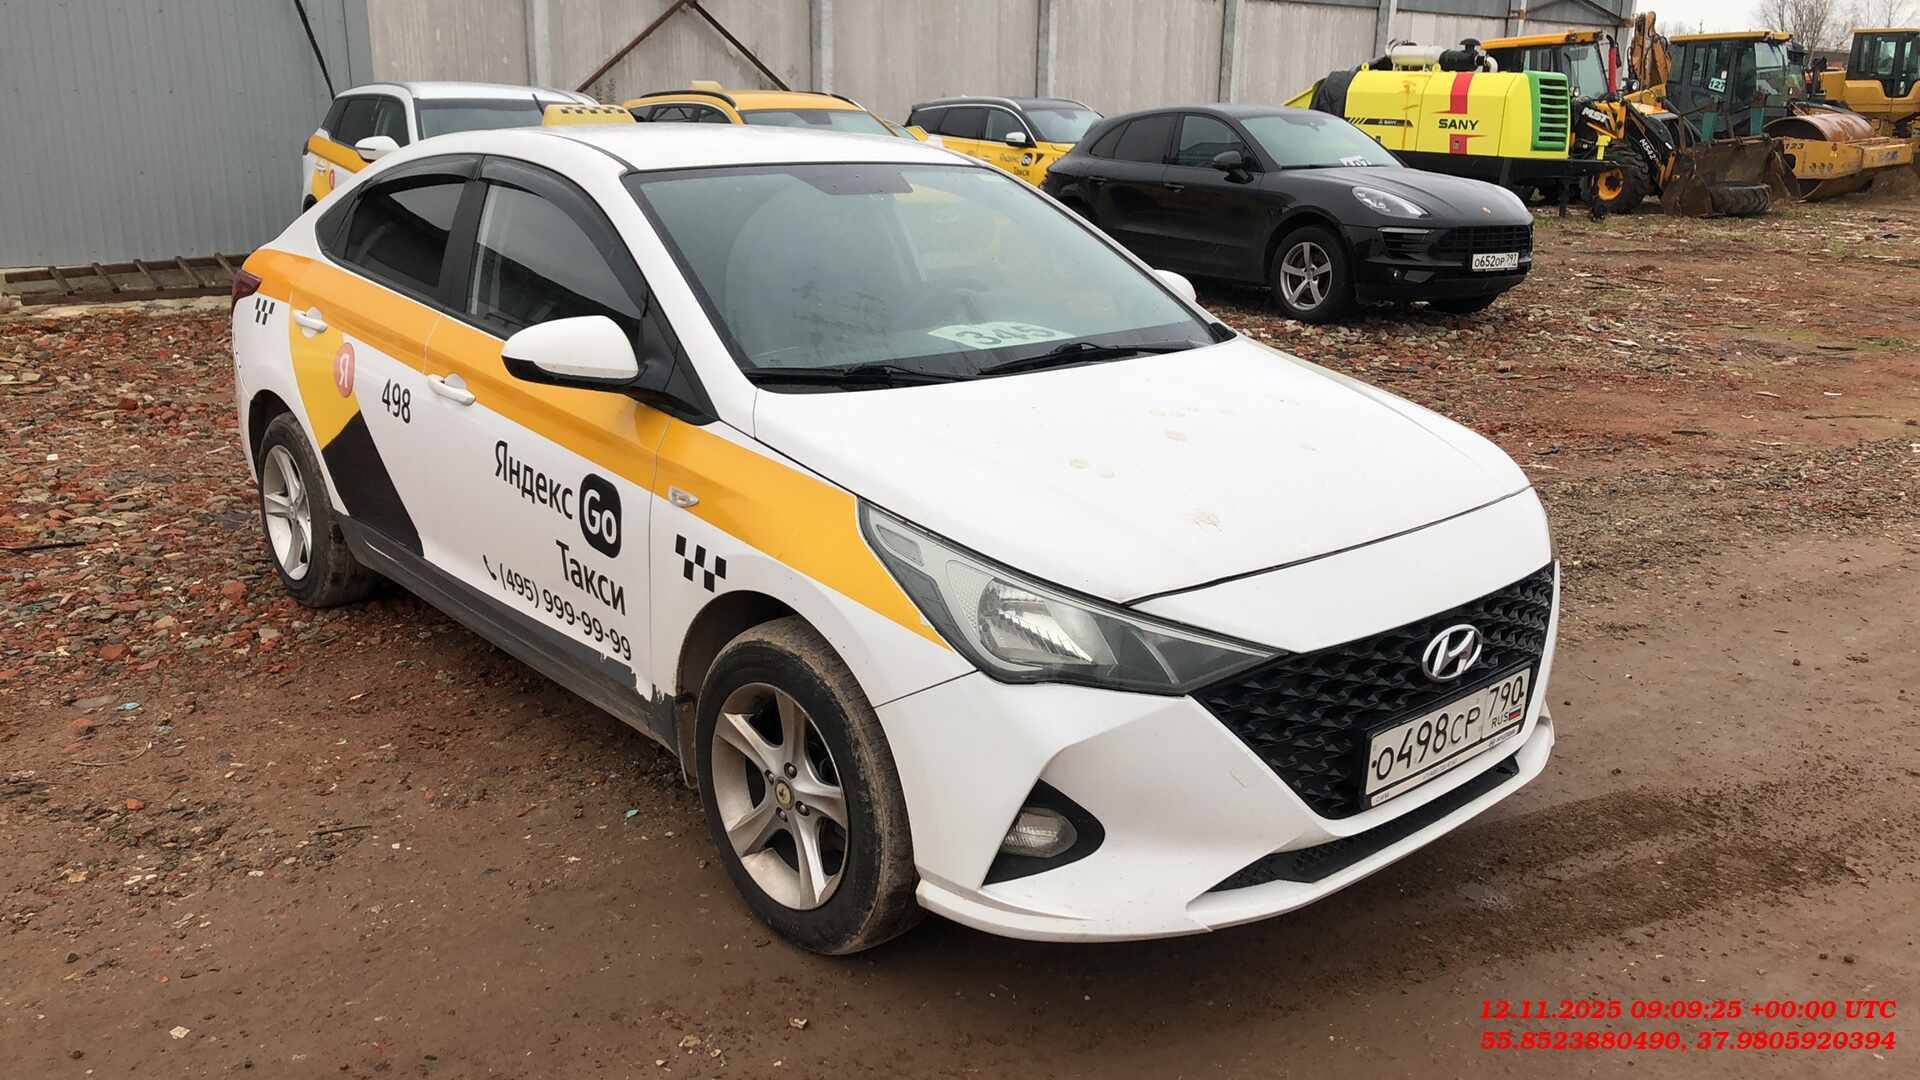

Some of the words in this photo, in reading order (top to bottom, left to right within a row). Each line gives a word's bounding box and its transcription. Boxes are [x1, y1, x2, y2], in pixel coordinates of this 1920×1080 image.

[1438, 118, 1479, 130] SANY
[955, 326, 1056, 345] 345
[381, 378, 411, 424] 498
[495, 440, 573, 520] Яндекс
[581, 486, 619, 547] Go
[555, 539, 626, 616] Такси
[499, 562, 539, 609] (495)
[543, 588, 632, 662] 999-99-99
[1376, 706, 1481, 780] О498СР
[1489, 675, 1525, 718] 790
[1491, 711, 1509, 729] RUS
